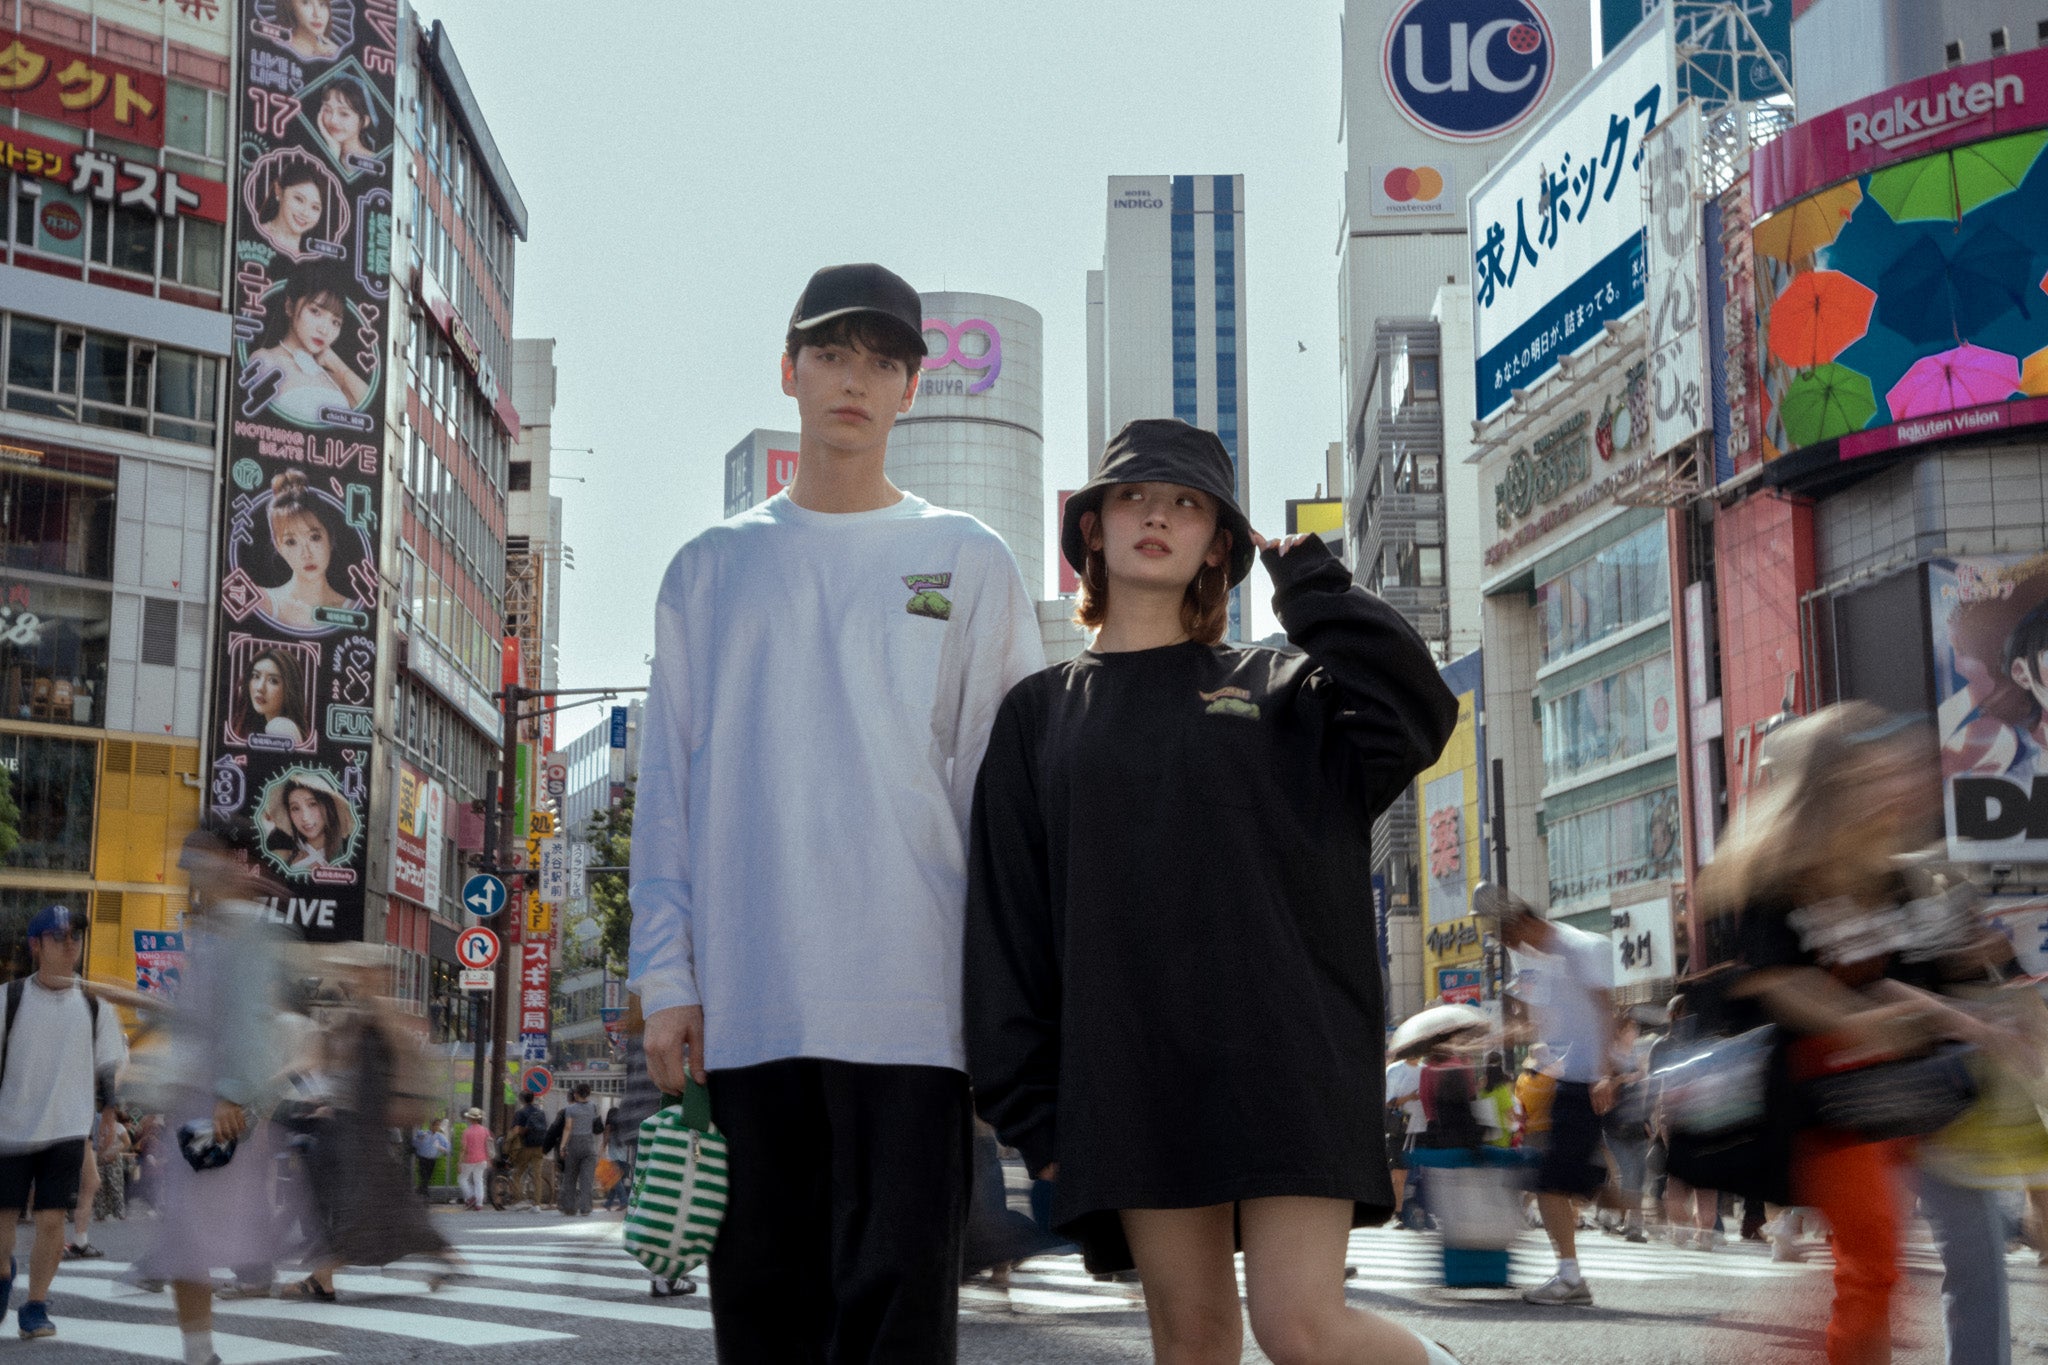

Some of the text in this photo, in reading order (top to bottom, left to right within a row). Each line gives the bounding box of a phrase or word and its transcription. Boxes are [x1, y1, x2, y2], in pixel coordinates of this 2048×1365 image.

[0, 40, 153, 123] タクト
[250, 48, 289, 73] LIVE
[1404, 19, 1537, 93] UC
[248, 87, 301, 138] 17
[1846, 73, 2025, 151] Rakuten
[72, 152, 200, 218] ガスト
[1113, 199, 1163, 209] INDIGO
[1386, 203, 1442, 213] mastercard
[1476, 83, 1662, 309] 求人ボックス
[921, 318, 1002, 395] 09
[1493, 281, 1621, 390] あなたの明日が、詰まってる。
[919, 379, 963, 395] IBUYA
[234, 420, 304, 446] NOTHING
[258, 441, 304, 461] BEATS
[1897, 409, 2000, 441] Rakuten Vision
[307, 434, 377, 474] LIVE
[1953, 778, 2048, 840] D
[550, 843, 563, 897] 渋谷駅前
[523, 942, 548, 1030] スギ薬局
